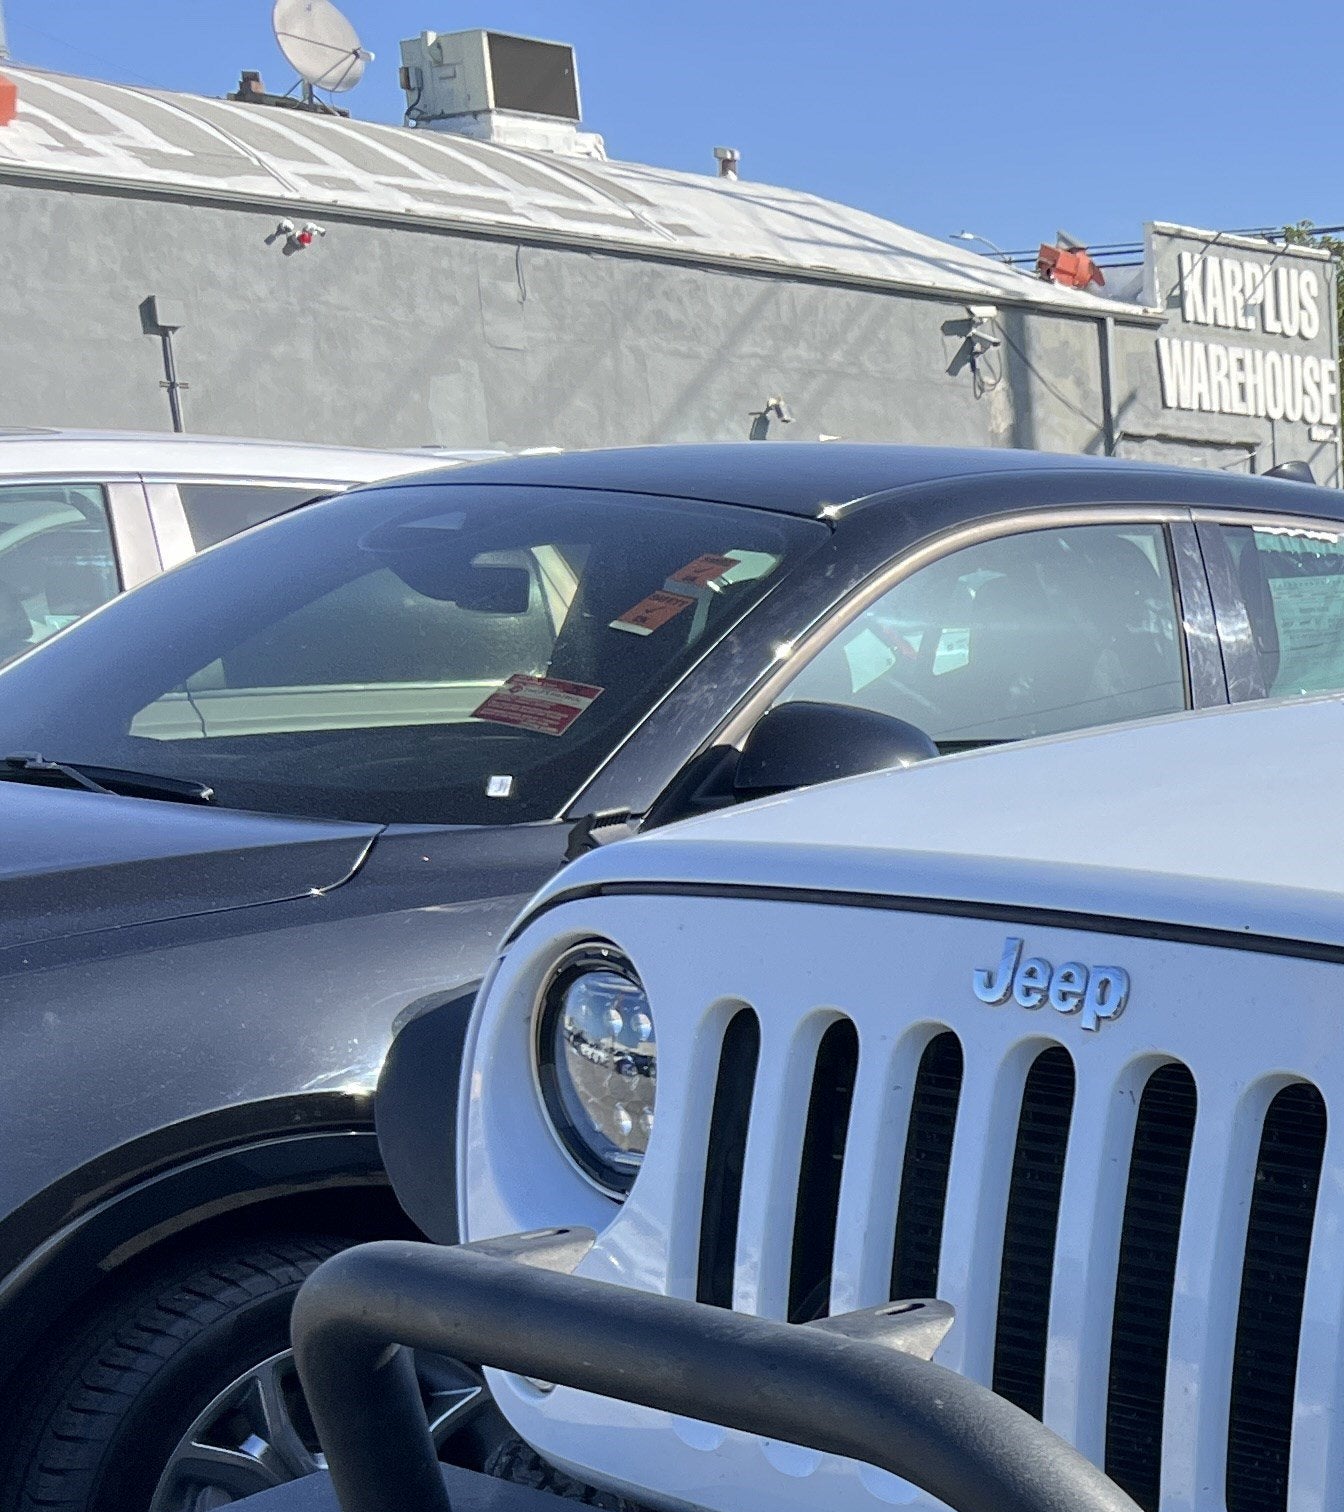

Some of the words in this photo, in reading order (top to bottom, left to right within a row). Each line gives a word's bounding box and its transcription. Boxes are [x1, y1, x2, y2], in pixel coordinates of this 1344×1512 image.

[1179, 251, 1320, 340] KARPLUS
[1157, 337, 1339, 425] WAREHOUSE
[972, 936, 1131, 1032] Jeep
